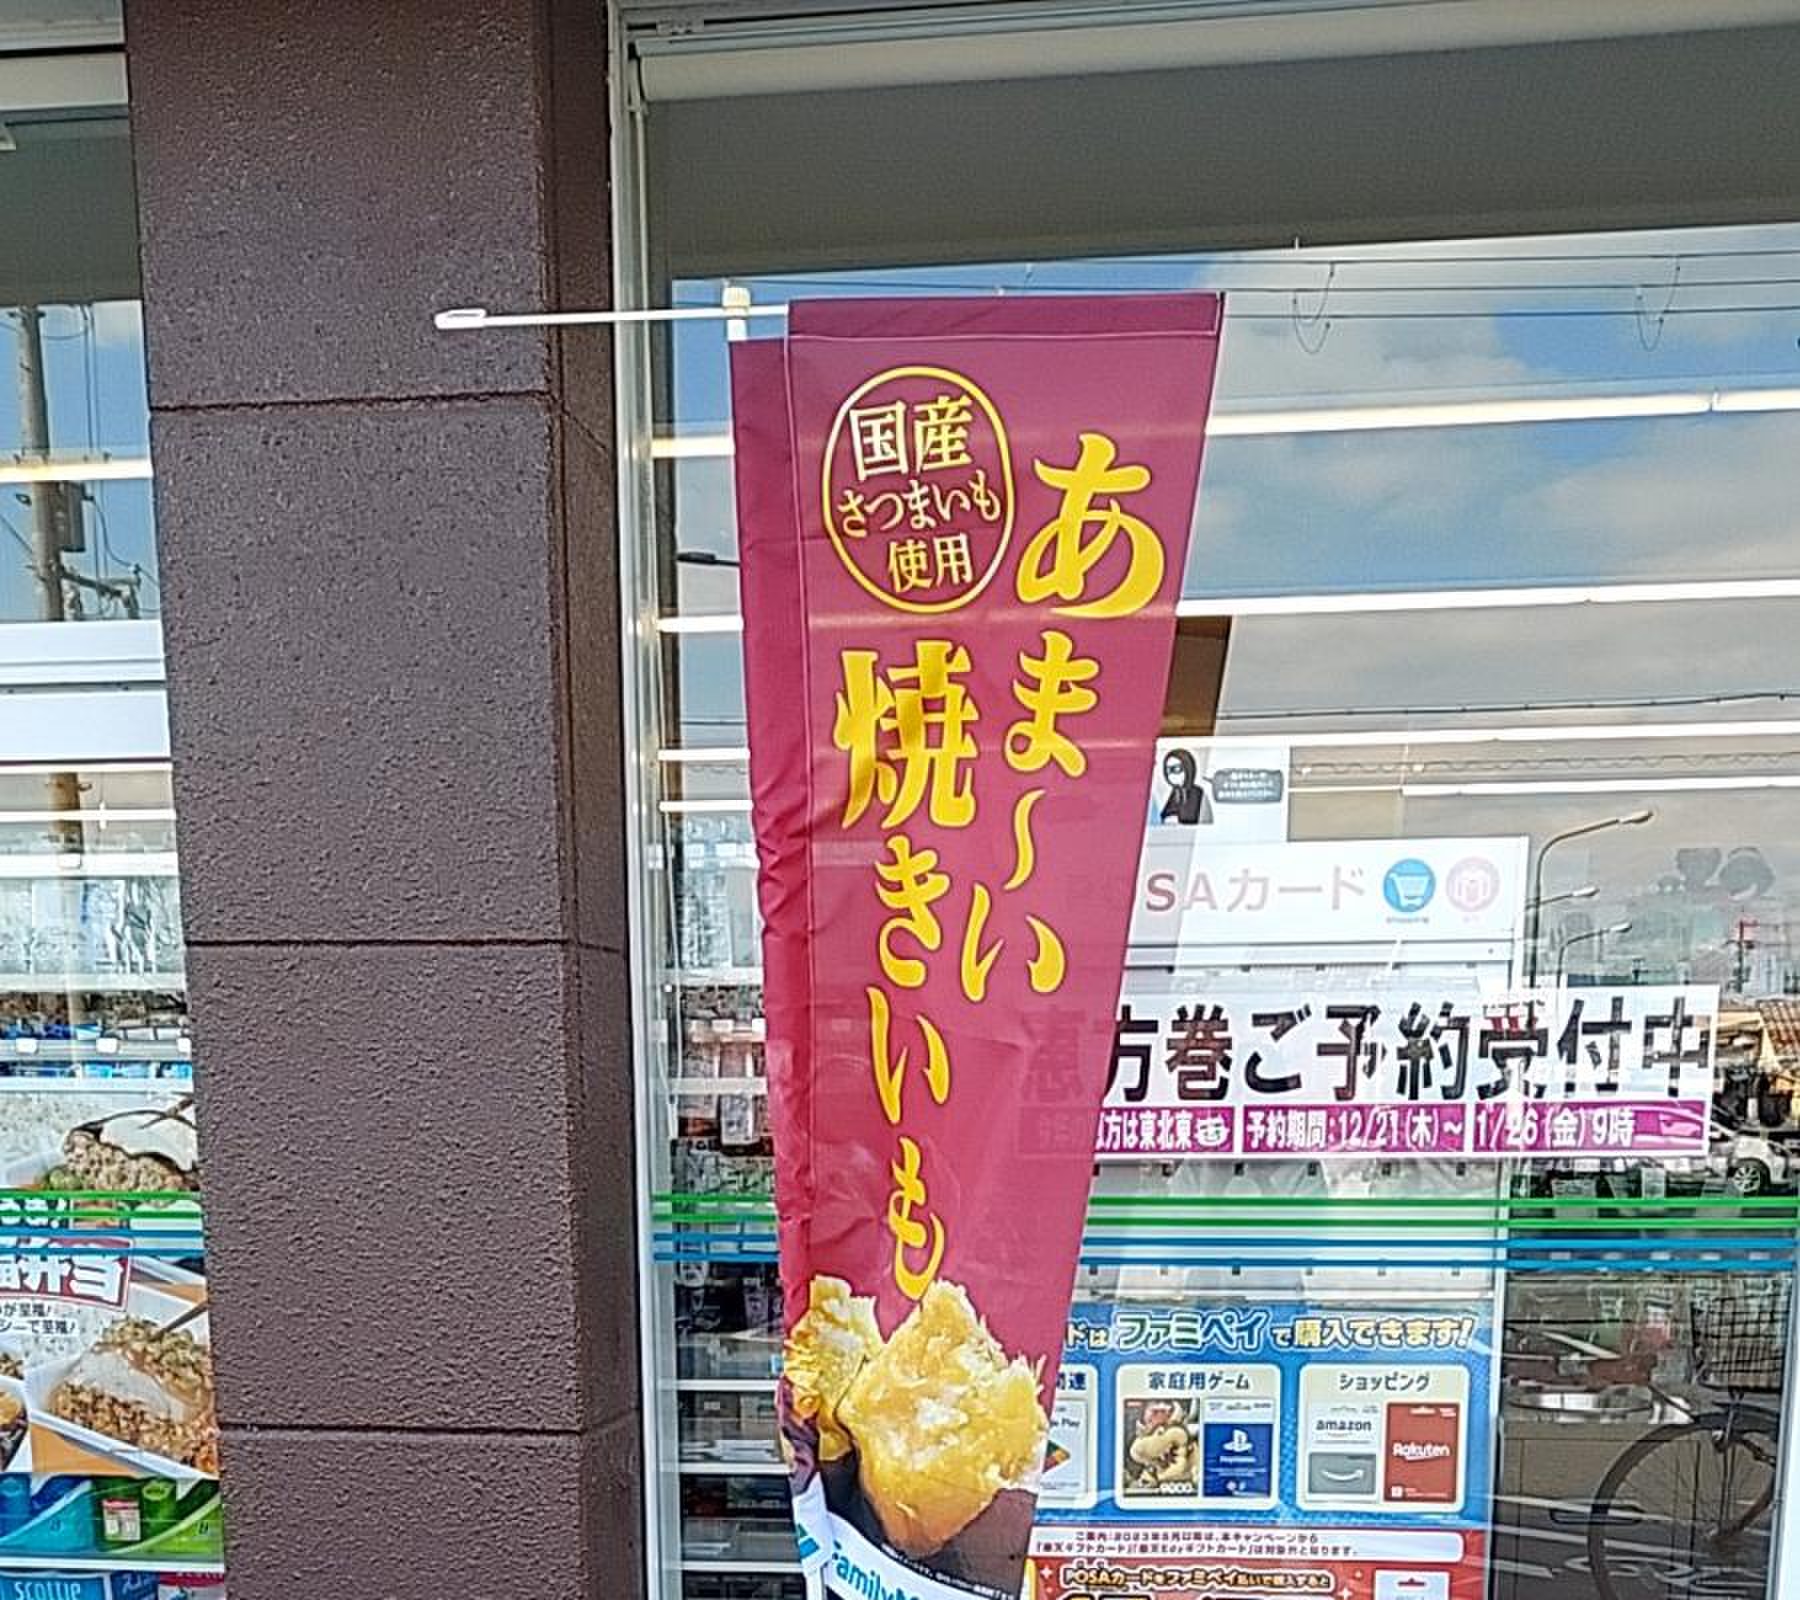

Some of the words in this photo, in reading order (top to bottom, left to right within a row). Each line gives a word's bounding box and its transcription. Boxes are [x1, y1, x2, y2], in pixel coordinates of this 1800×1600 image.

[848, 394, 974, 480] 国産
[837, 469, 1001, 538] さつまいも
[888, 533, 974, 593] 使用
[833, 641, 979, 1300] 焼きいも
[1096, 1110, 1193, 1150] 方は東北東
[1148, 1370, 1250, 1391] 家庭用ゲーム
[1339, 1372, 1430, 1392] ショッピング
[1315, 1419, 1372, 1432] amazon
[1392, 1441, 1451, 1458] Rakuten
